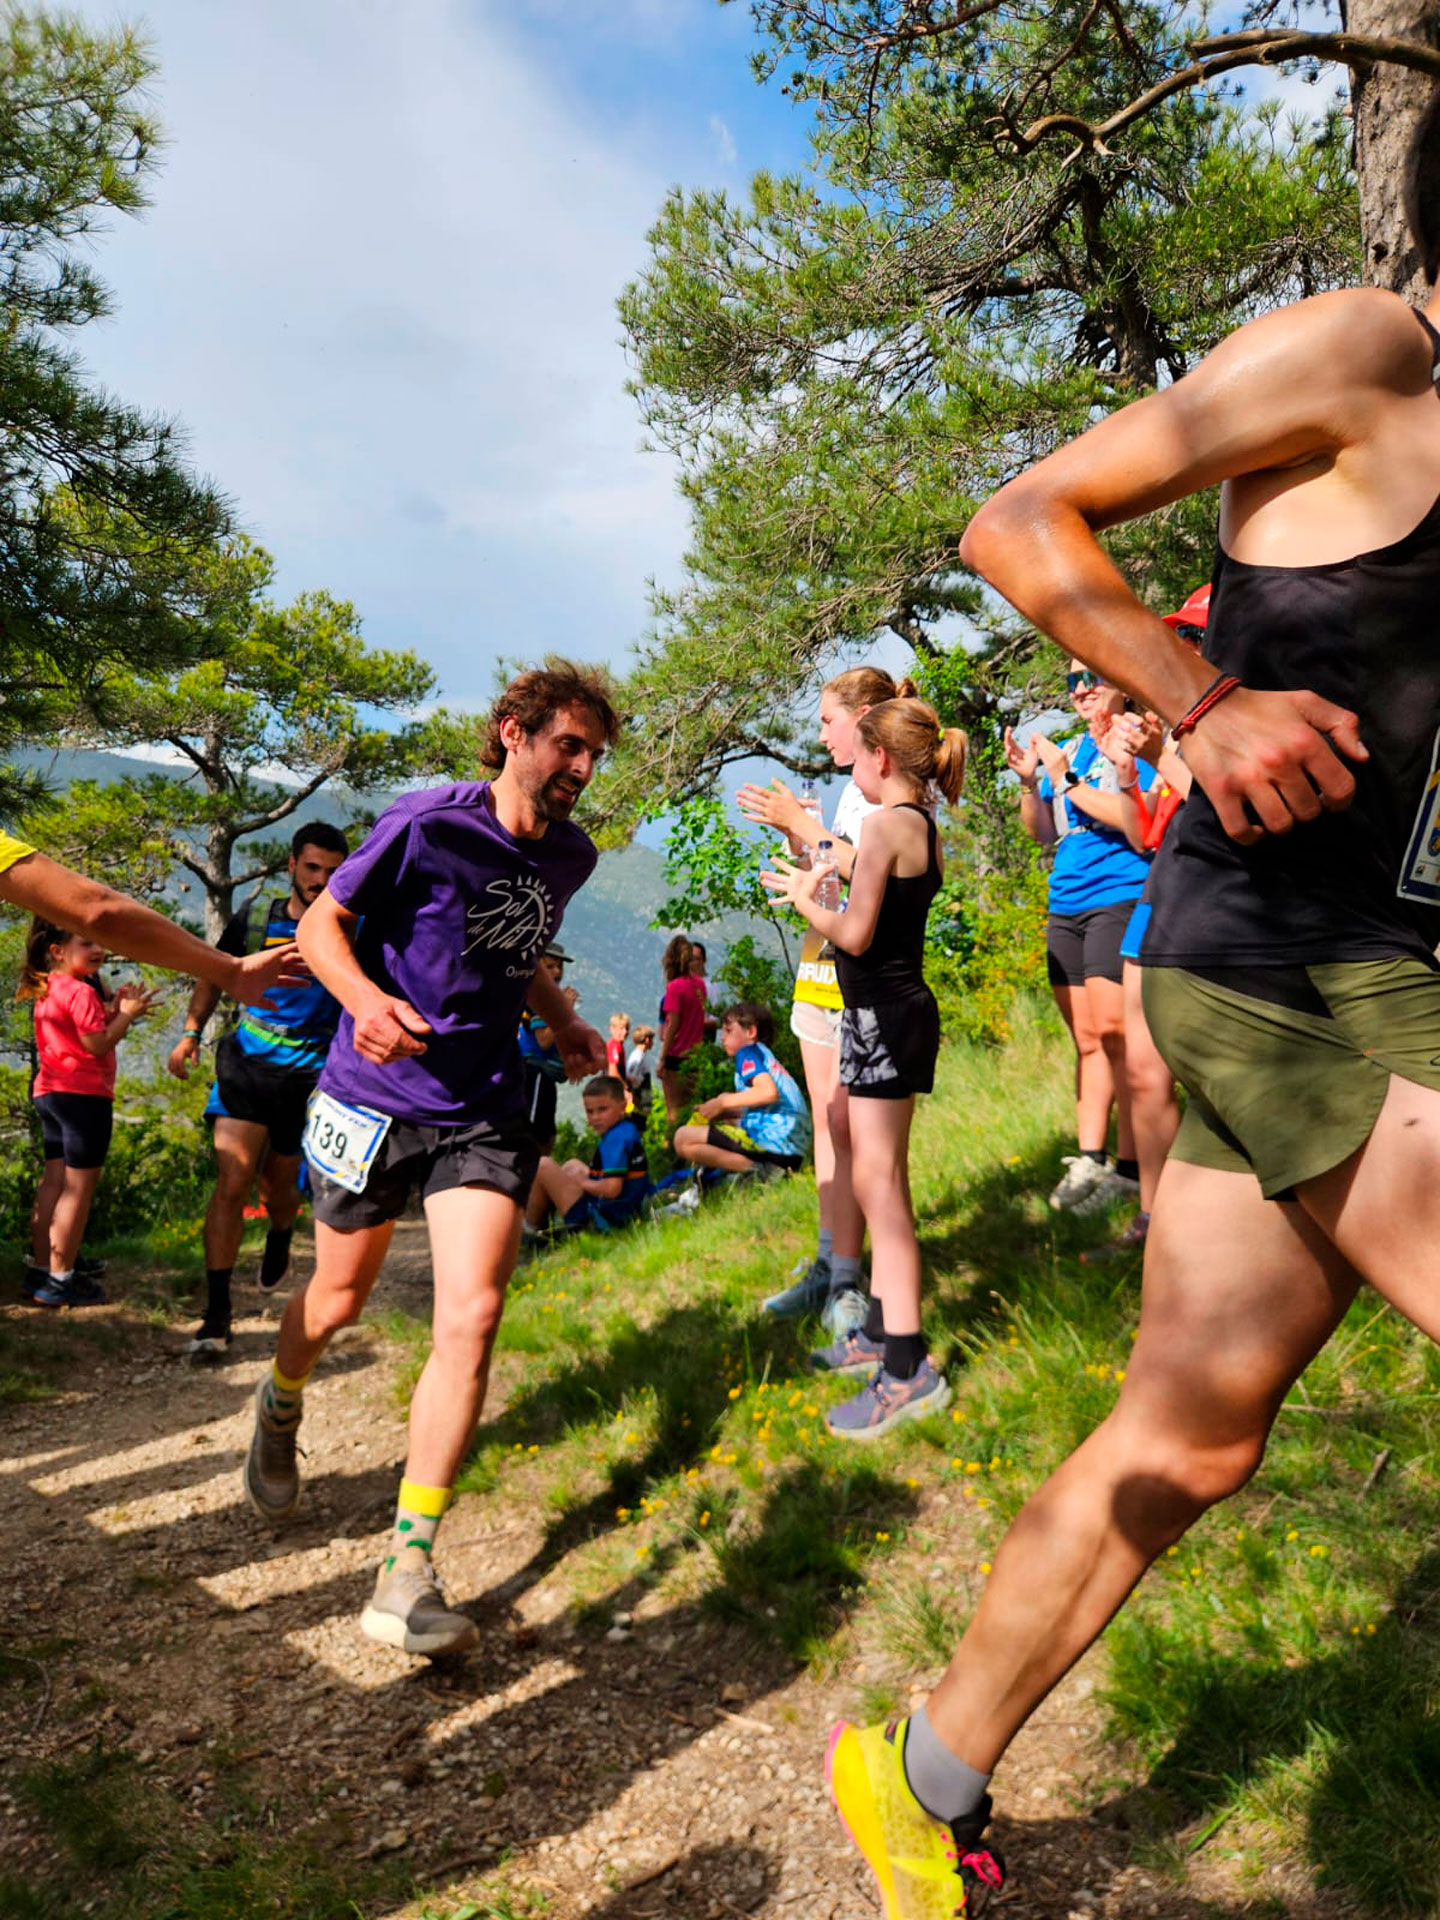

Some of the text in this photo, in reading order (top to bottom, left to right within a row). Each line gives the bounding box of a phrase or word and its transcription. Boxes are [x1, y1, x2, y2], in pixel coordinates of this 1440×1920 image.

[467, 880, 539, 918] Sol
[460, 912, 540, 956] Nit
[312, 1114, 347, 1159] 139
